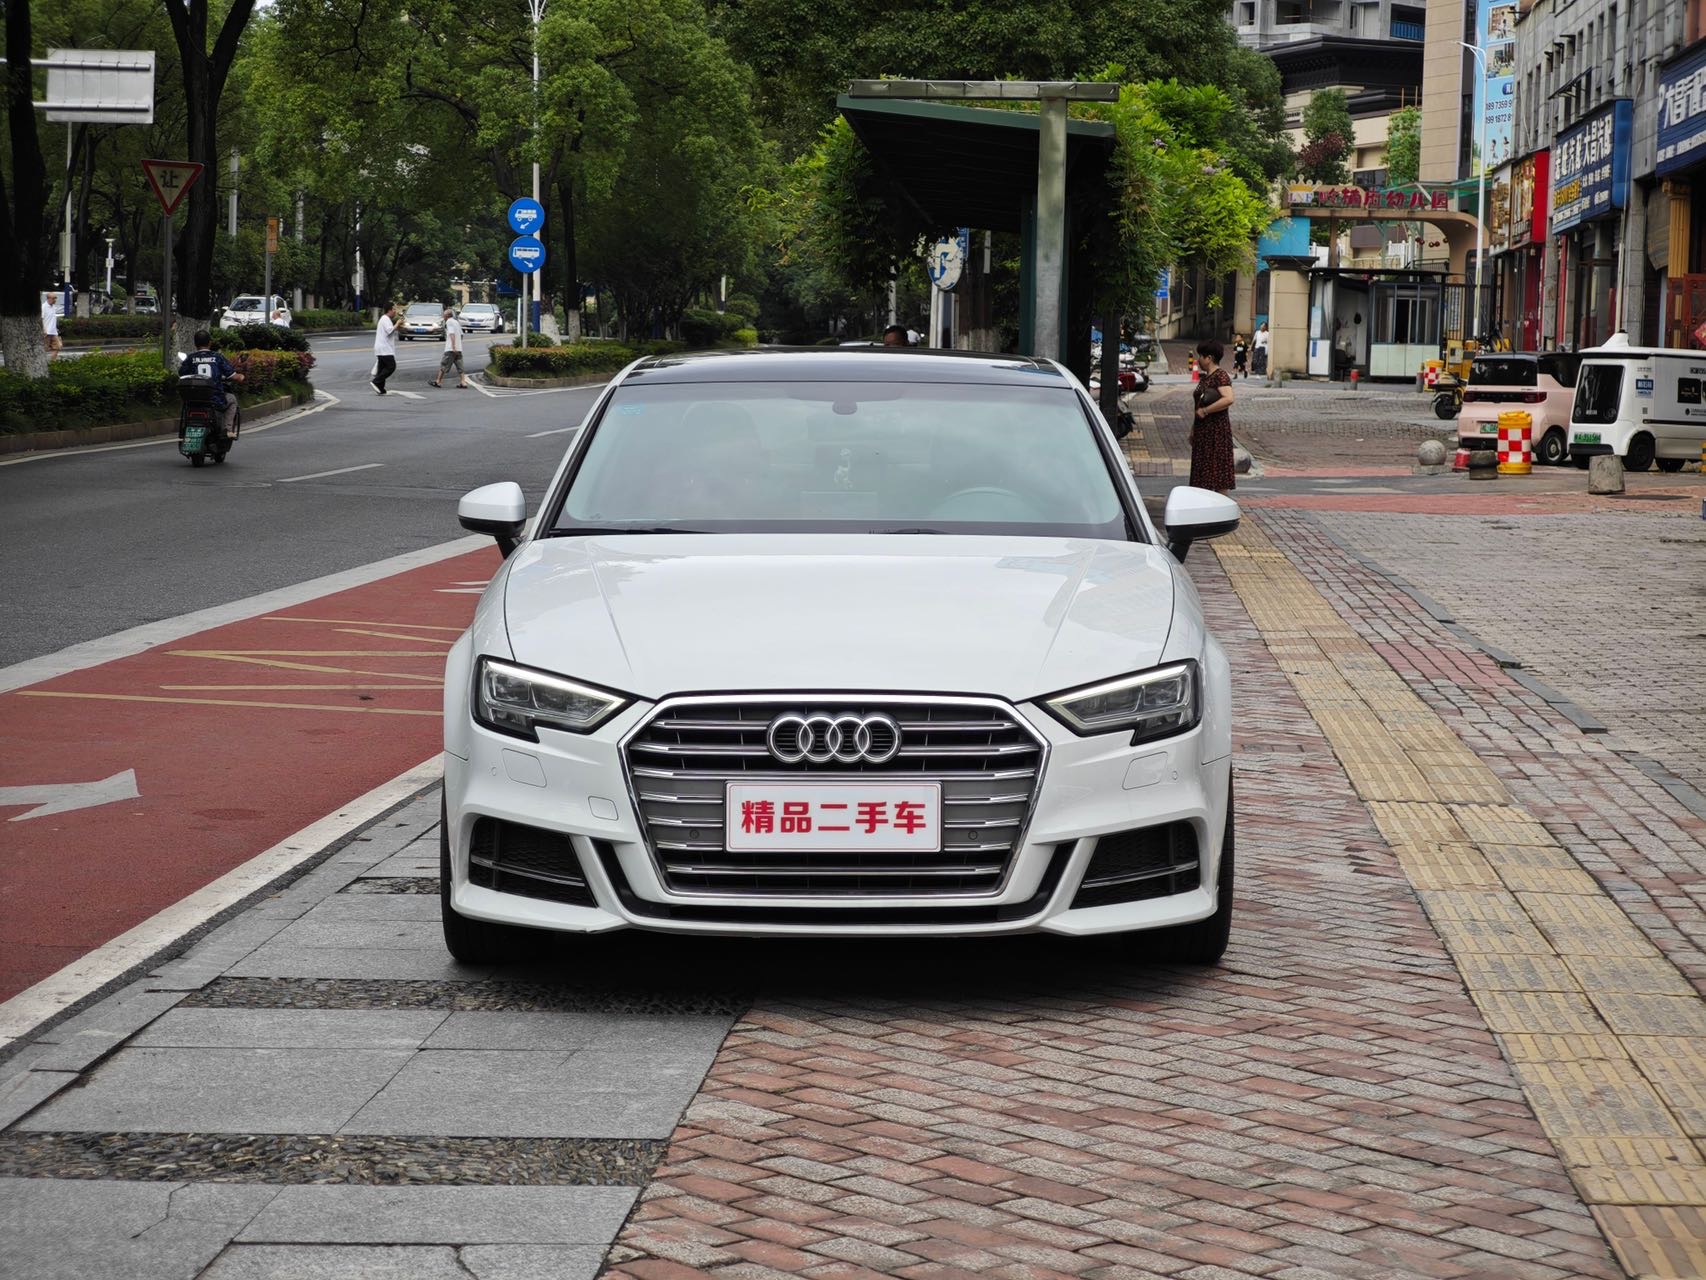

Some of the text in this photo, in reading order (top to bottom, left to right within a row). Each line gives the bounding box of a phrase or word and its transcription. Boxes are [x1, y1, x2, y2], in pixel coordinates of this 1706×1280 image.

[161, 170, 179, 188] 让
[741, 800, 926, 834] 精品二手车
